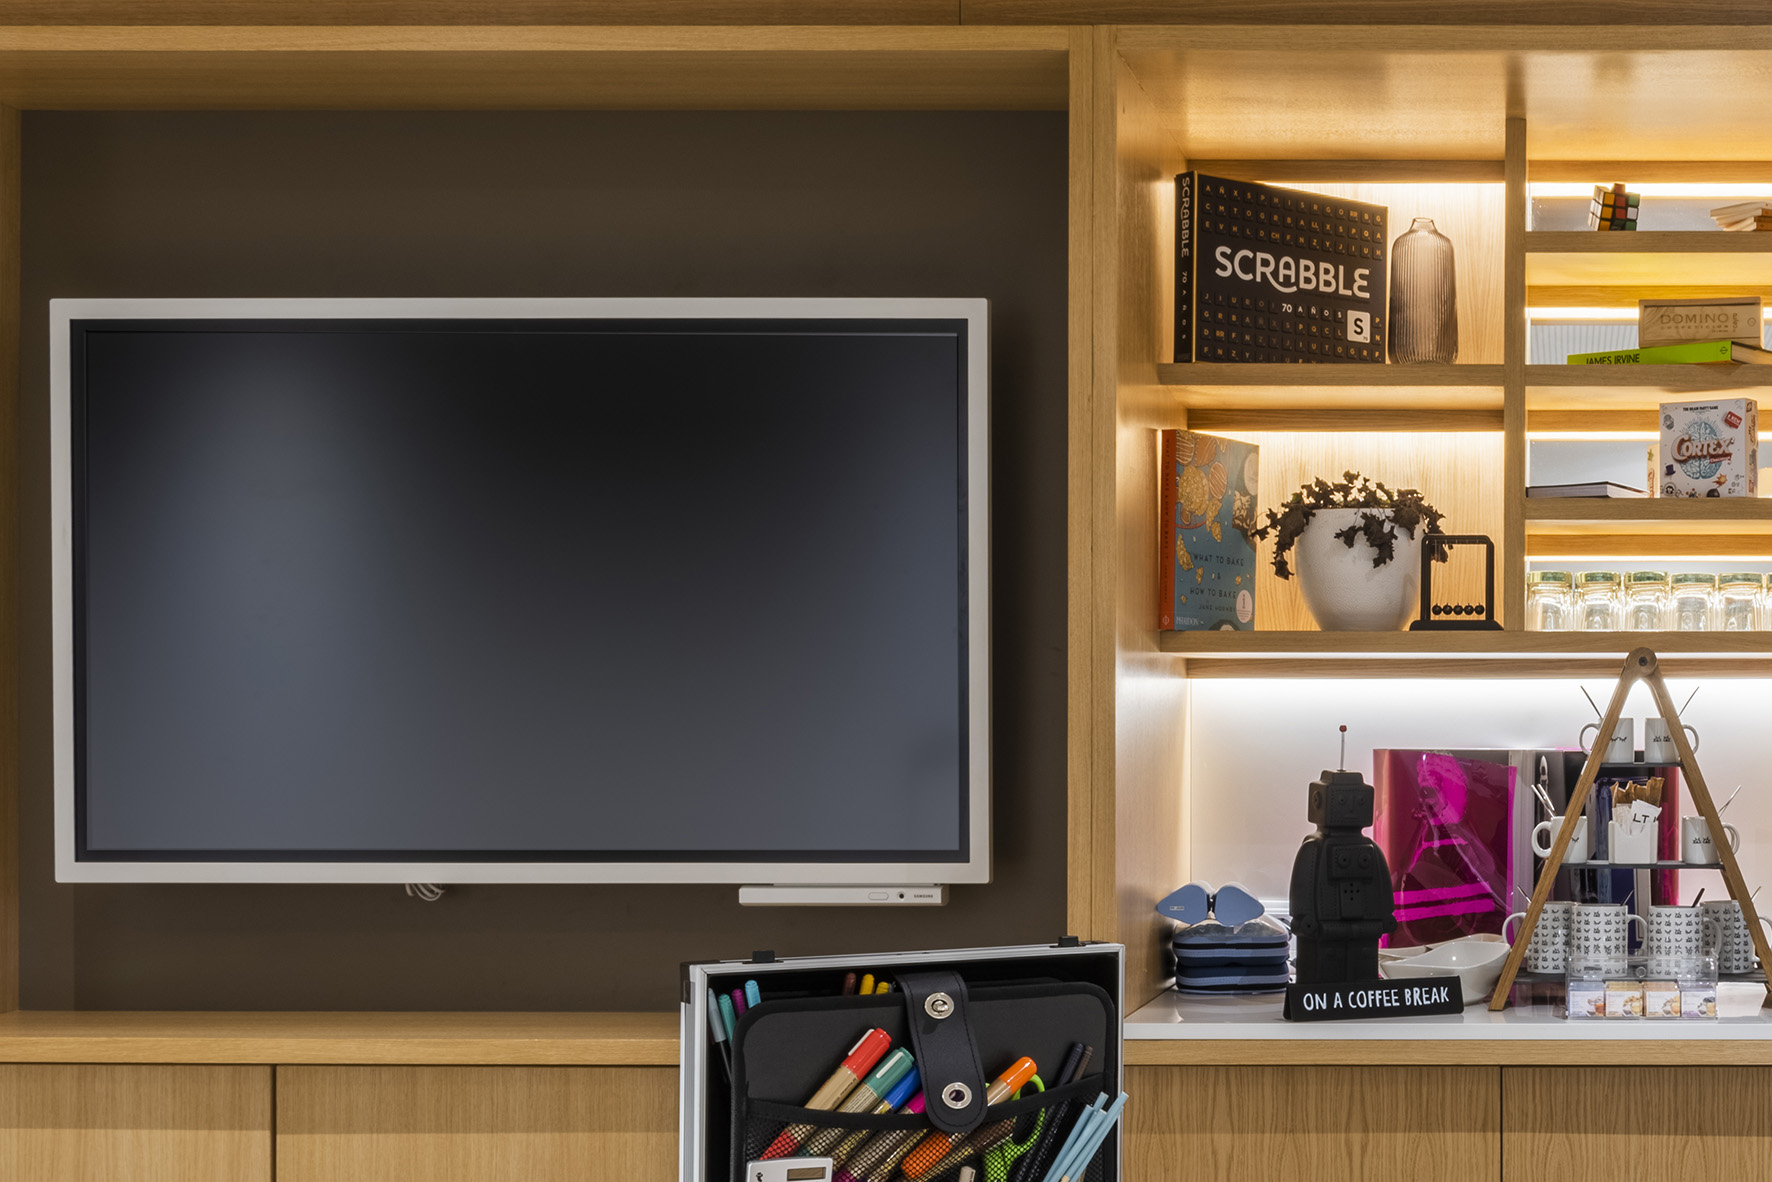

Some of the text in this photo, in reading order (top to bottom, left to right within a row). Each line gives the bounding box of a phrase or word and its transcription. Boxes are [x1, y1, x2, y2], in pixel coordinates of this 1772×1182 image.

[1181, 177, 1190, 258] SCRABBLE
[1182, 271, 1188, 283] 70
[1215, 245, 1371, 299] SCRABBLE
[1281, 303, 1293, 313] 70
[1660, 313, 1729, 325] DOMINO
[1353, 317, 1364, 335] S
[1586, 353, 1640, 365] JAMES IRVINE
[1671, 433, 1730, 461] CORTEX
[1194, 553, 1244, 566] WHAT TO BAKE
[1189, 587, 1237, 599] HOW TO BAKE
[1303, 986, 1450, 1011] ON A COFFEE BREAK
